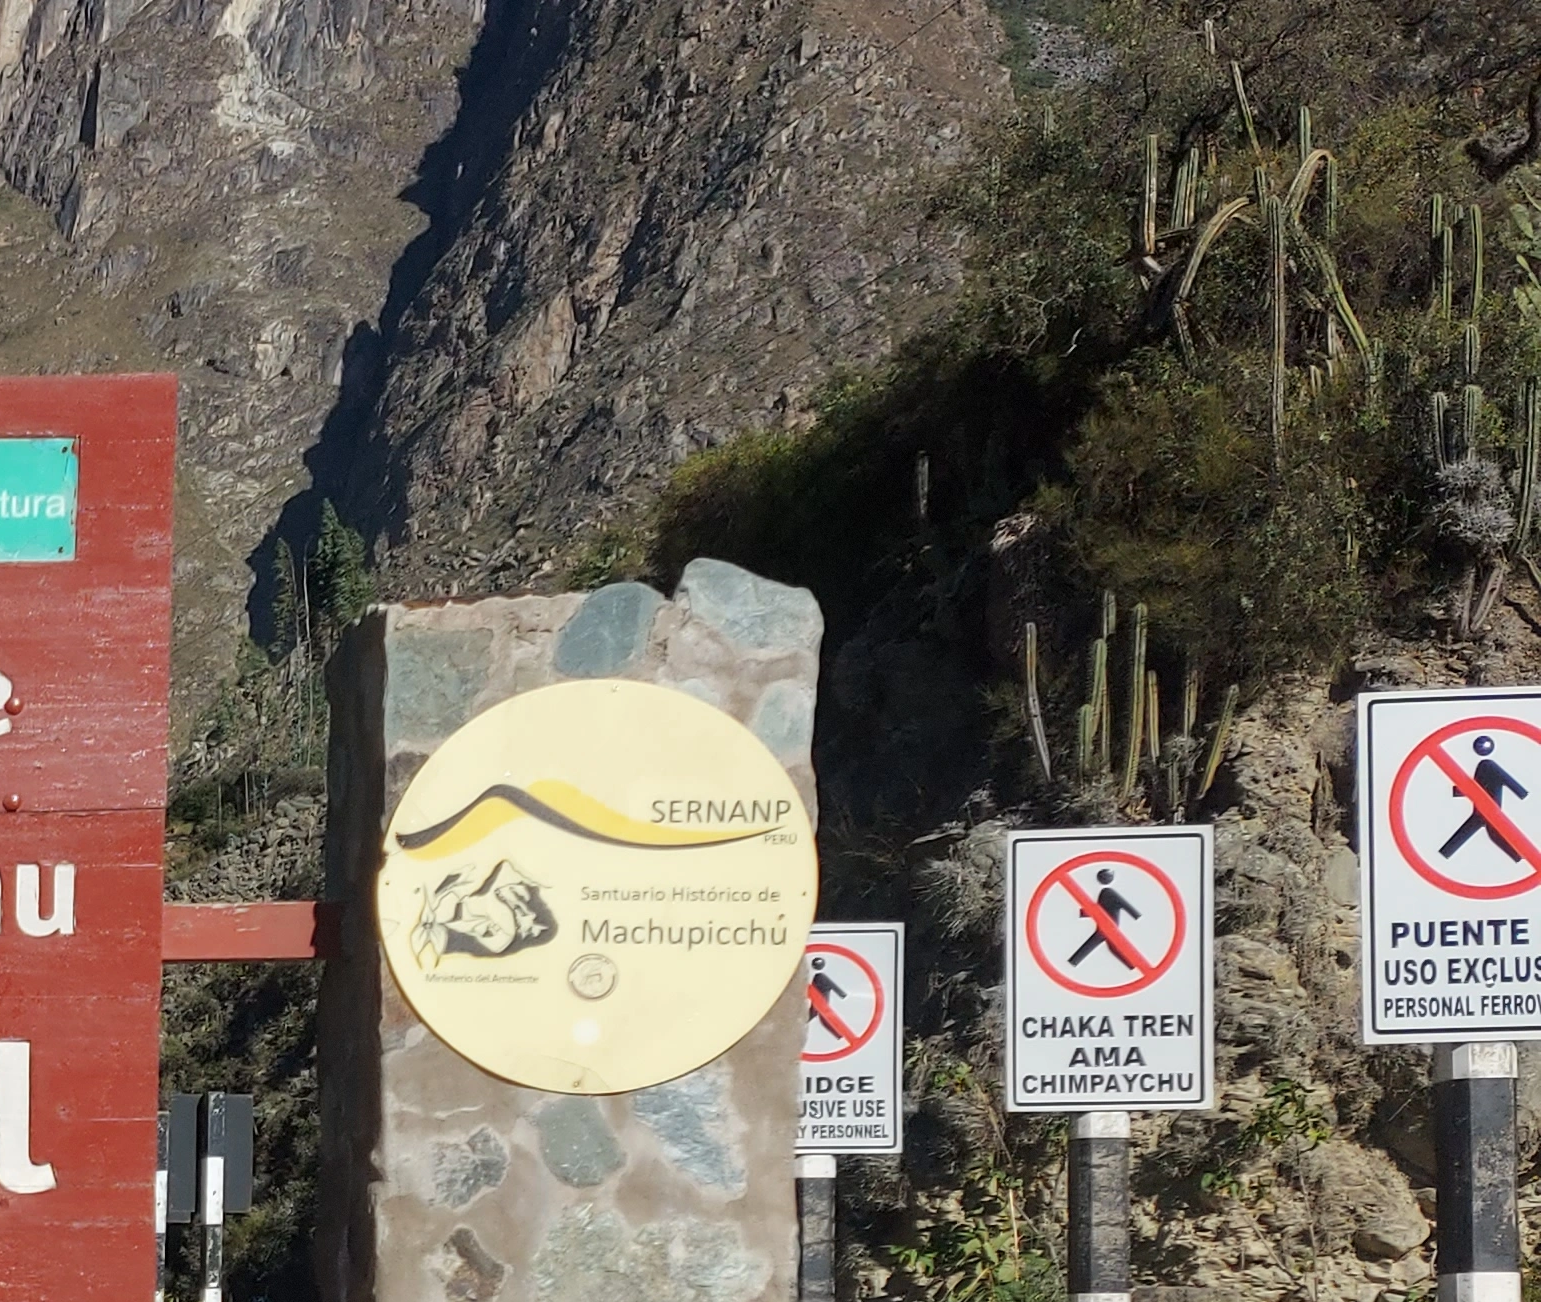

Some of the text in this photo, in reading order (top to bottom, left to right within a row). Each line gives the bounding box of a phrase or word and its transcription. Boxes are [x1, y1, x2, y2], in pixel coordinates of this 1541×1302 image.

[651, 799, 792, 823] SERNANP
[581, 886, 780, 902] Santuario Histórico de
[1391, 918, 1530, 948] PUENTE
[1384, 959, 1437, 986] USO
[1384, 996, 1475, 1018] PERSONAL
[1022, 1014, 1194, 1038] CHAKA TREN
[1068, 1047, 1147, 1068] AMA
[805, 1076, 875, 1094] IDGE
[1022, 1072, 1194, 1094] CHIMPAYCHU
[853, 1100, 886, 1118] USE
[811, 1124, 890, 1139] PERSONNEL
